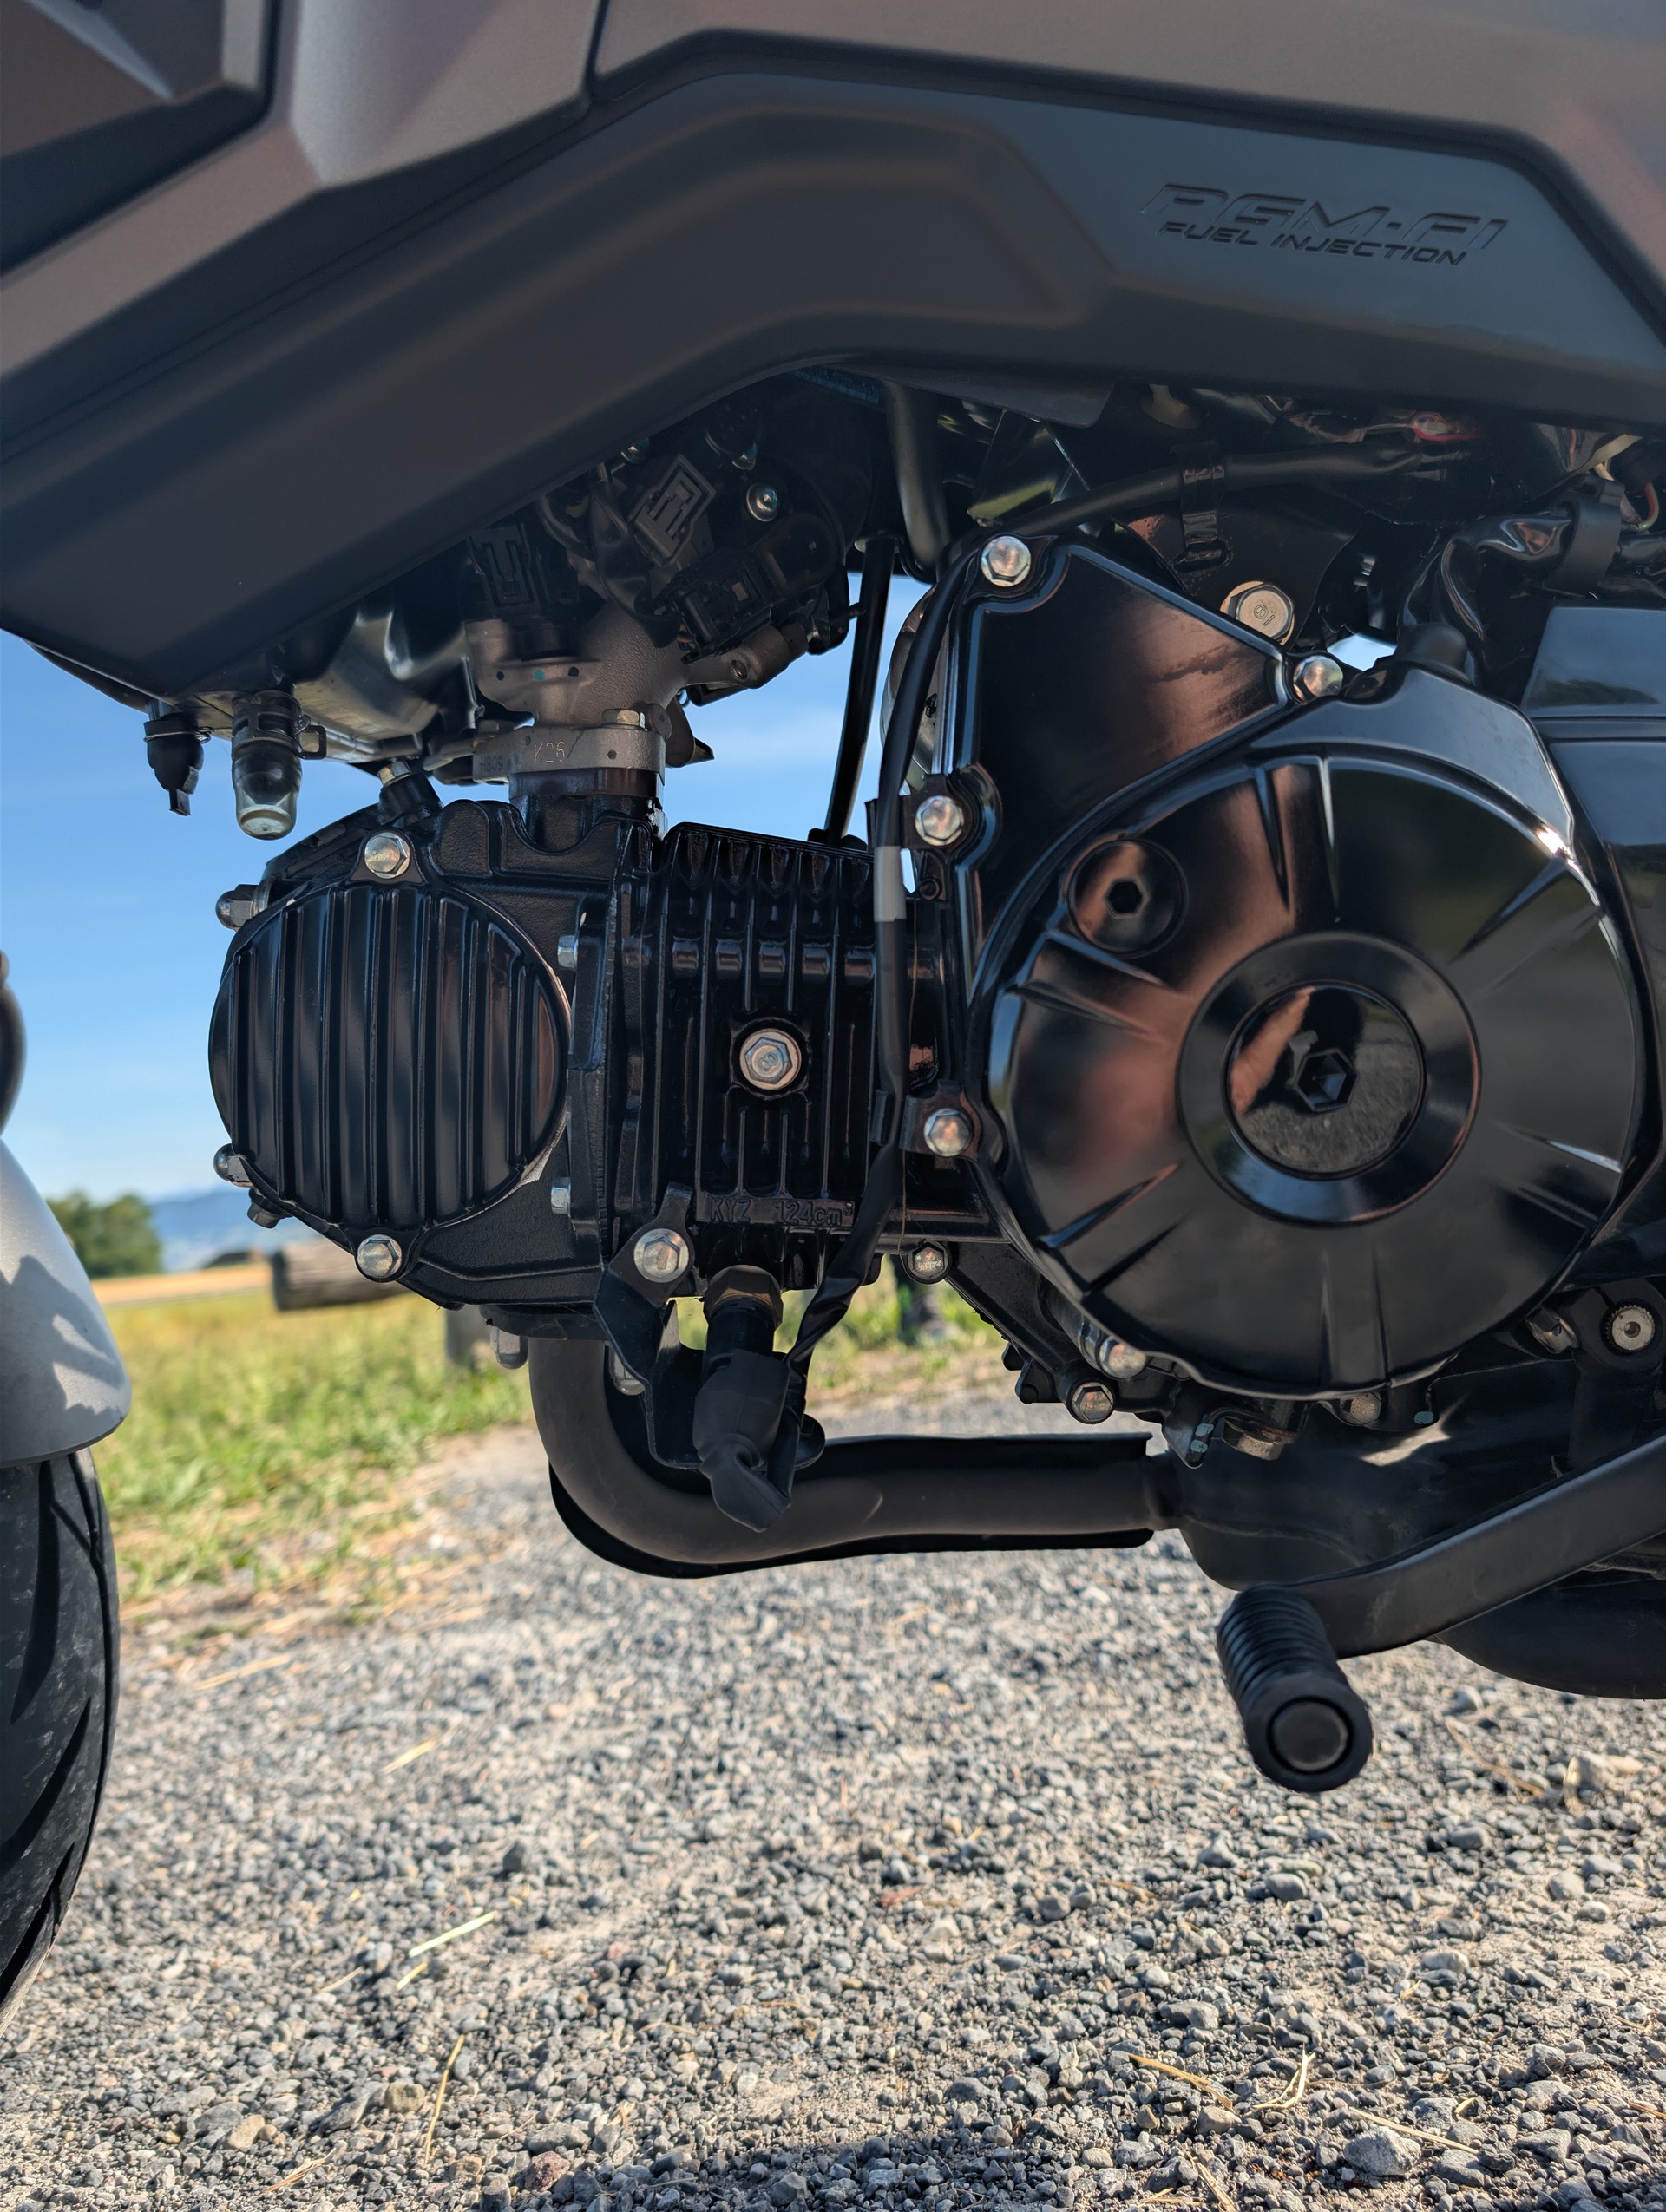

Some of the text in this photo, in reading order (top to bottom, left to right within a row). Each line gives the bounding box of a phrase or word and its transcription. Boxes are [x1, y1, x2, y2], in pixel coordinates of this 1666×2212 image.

[1155, 220, 1468, 266] FUEL INJECTION
[709, 1196, 751, 1222] KYZ
